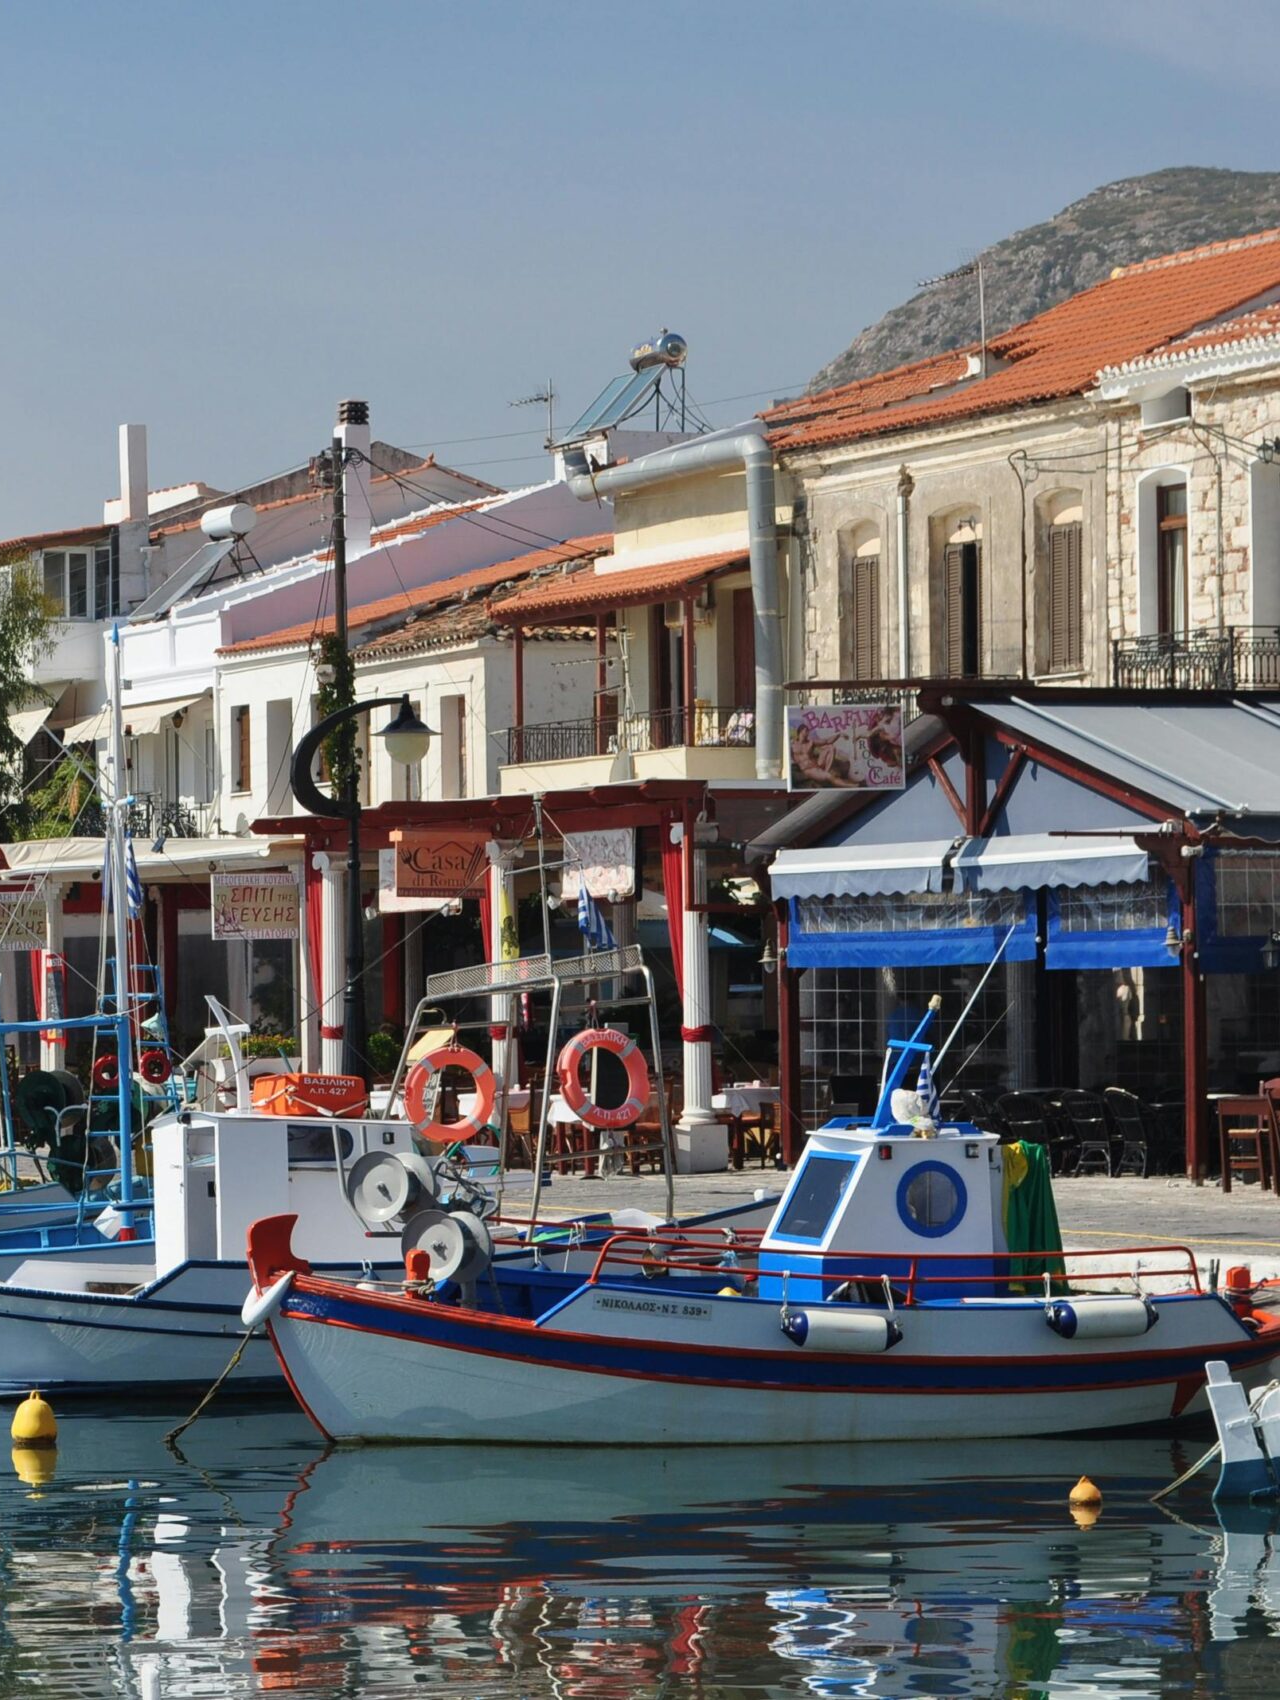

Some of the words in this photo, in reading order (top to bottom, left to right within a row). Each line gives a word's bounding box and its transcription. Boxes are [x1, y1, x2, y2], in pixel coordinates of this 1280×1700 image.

[803, 710, 878, 733] BARFLY
[868, 766, 901, 785] Café
[412, 847, 467, 871] Casa
[231, 887, 274, 902] ΣΠΙΤΙ
[231, 906, 296, 922] ΓΕΥΣΗΣ
[581, 1032, 629, 1046] ΒΑΣΙΛΙΚΗ
[303, 1077, 355, 1088] ΒΑΣΙΛΙΚΗ
[329, 1087, 347, 1096] 427
